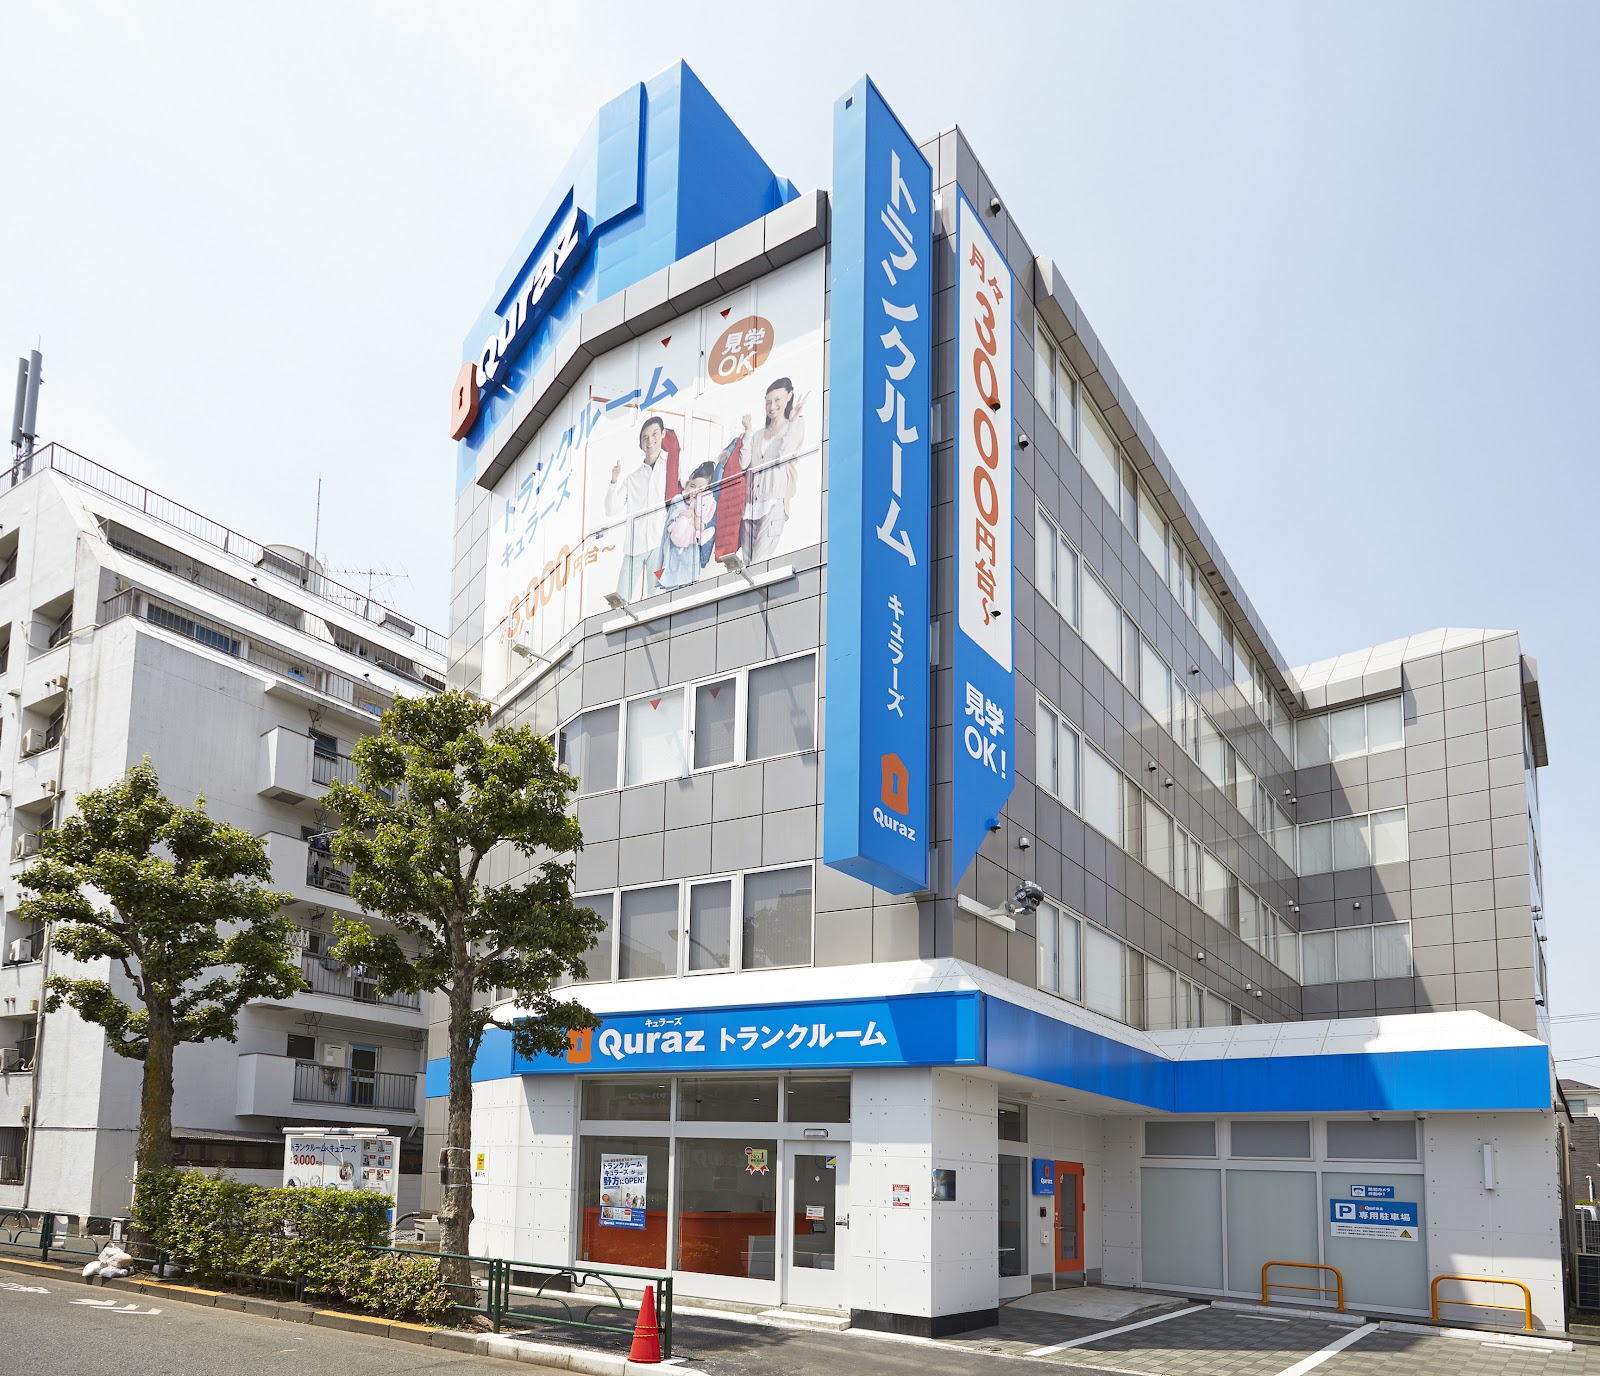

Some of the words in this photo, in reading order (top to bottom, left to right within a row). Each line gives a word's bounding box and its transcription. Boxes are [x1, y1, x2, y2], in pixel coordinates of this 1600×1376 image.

[476, 206, 578, 387] Quraz
[721, 328, 765, 355] 見学
[875, 148, 919, 566] トランクルーム
[718, 351, 758, 376] OK
[504, 366, 679, 533] トランクルーム
[501, 469, 573, 568] キュラーズ
[887, 594, 905, 717] キュラーズ
[964, 682, 1004, 737] 見学
[964, 725, 1006, 779] OK!
[873, 806, 916, 841] Quraz
[645, 1016, 683, 1028] キュラーズ
[598, 1028, 705, 1061] Quraz
[720, 1021, 888, 1052] トランクルーム
[603, 1161, 642, 1169] トランクルーム
[603, 1176, 645, 1186] 野方にOPEN!
[1340, 1205, 1352, 1217] P
[1359, 1211, 1411, 1222] 専用駐車場
